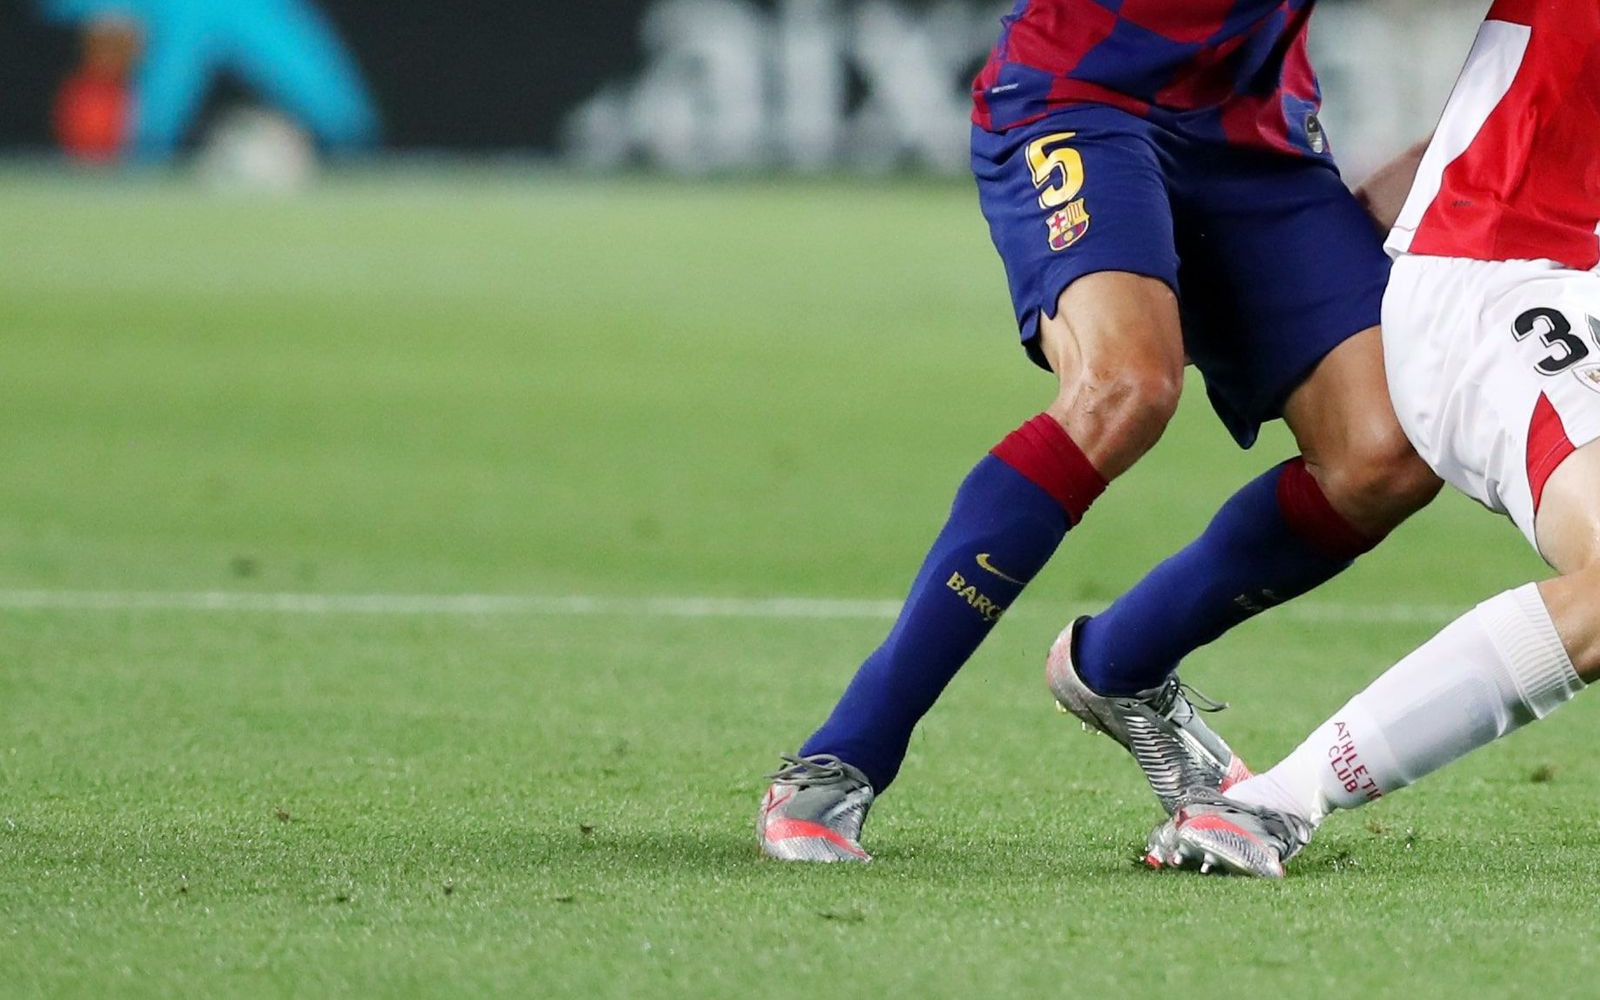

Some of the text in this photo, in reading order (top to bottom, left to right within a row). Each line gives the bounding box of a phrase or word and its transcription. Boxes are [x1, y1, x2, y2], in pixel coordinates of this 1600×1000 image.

[1026, 131, 1086, 209] 5
[946, 571, 1004, 621] BARÇ
[1328, 745, 1358, 793] CLUB
